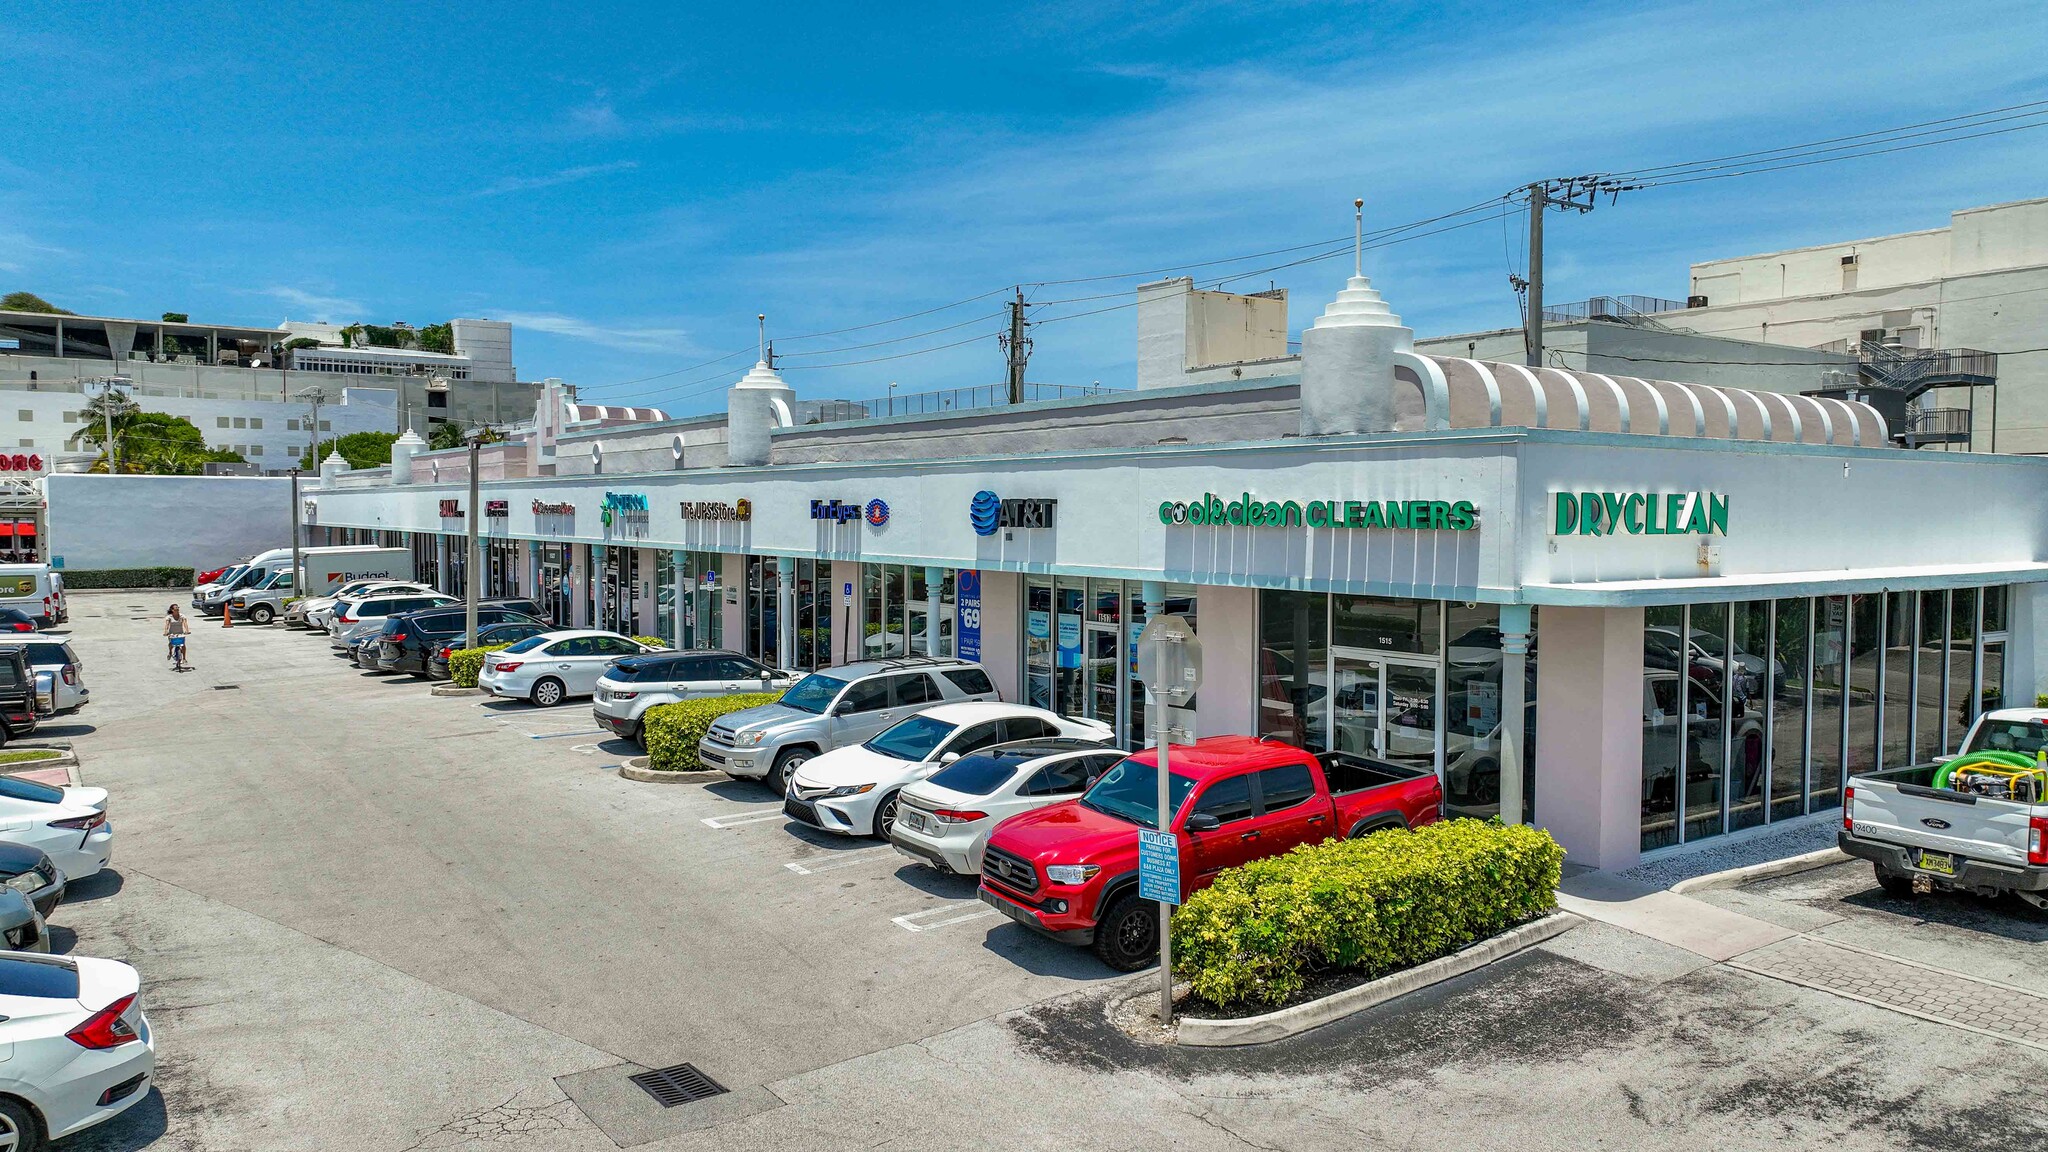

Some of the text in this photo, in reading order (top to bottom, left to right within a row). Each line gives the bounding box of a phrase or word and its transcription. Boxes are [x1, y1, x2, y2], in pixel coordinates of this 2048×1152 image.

[680, 501, 736, 520] The UPS Store
[999, 498, 1056, 528] AT&T
[1306, 500, 1476, 531] CLEANERS
[345, 571, 389, 582] Budget
[965, 599, 980, 608] PAIRS
[961, 608, 980, 629] $69
[1378, 636, 1392, 645] 1515
[1853, 822, 1877, 835] 19400
[1926, 818, 1946, 829] Ford
[1142, 832, 1173, 846] NOTICE
[1145, 843, 1161, 853] PARKING
[1141, 849, 1177, 862] CUSTOMERS DOING
[1147, 857, 1165, 867] BUSINESS
[1152, 865, 1164, 873] PLAZA
